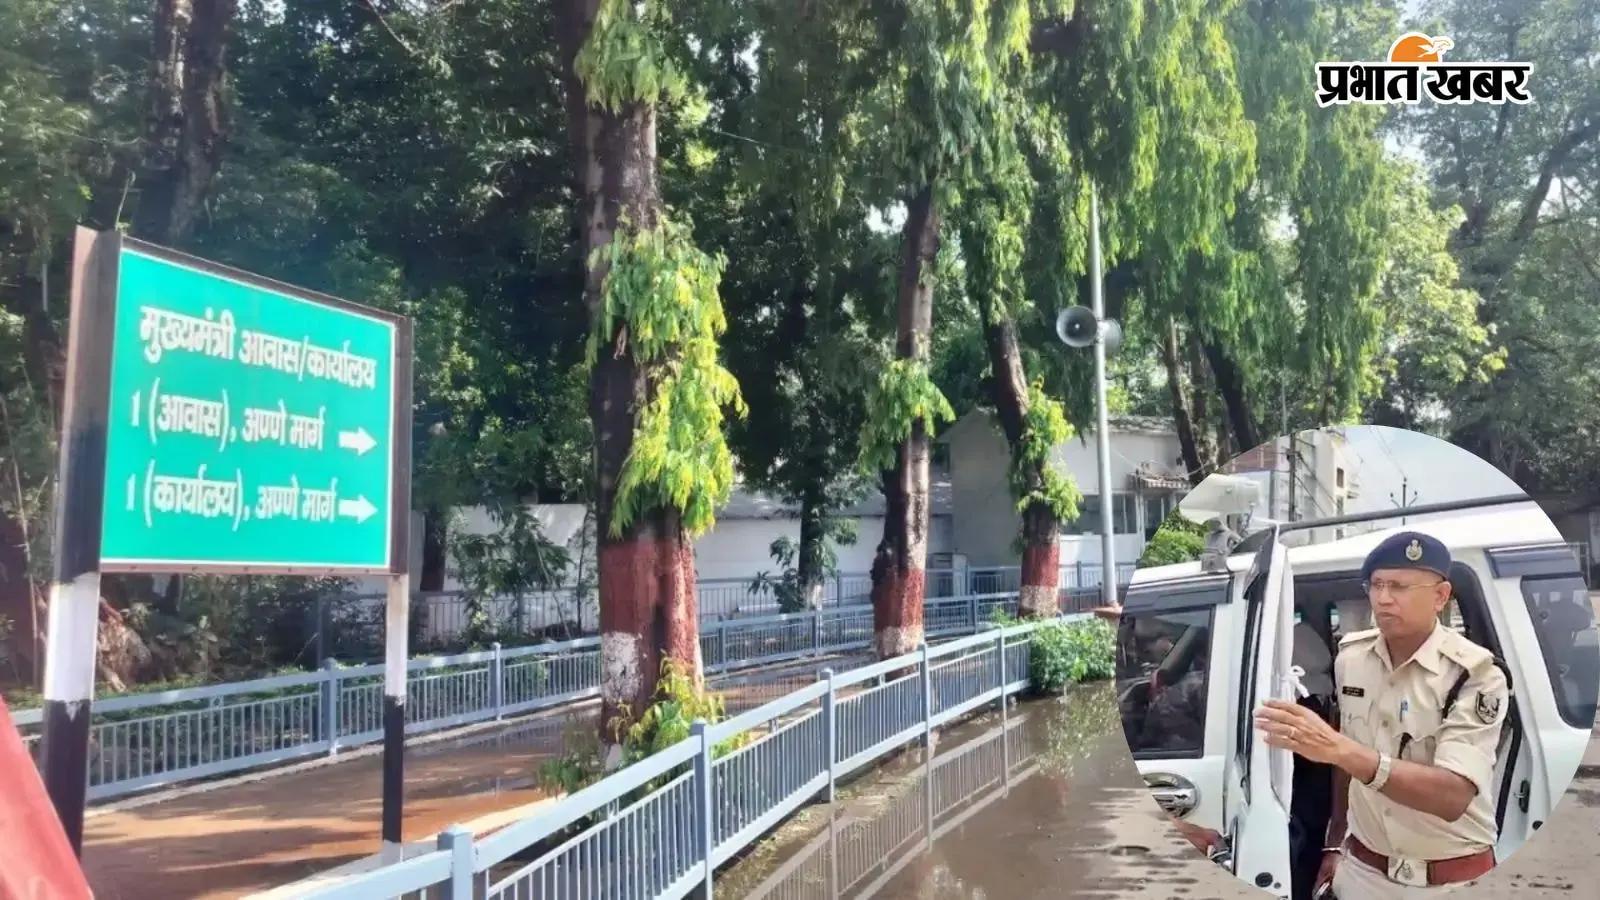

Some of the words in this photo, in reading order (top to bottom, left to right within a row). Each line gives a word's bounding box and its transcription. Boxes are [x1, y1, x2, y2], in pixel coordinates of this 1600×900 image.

[139, 306, 236, 364] मुख्यमंत्री
[238, 329, 378, 390] आवास/कार्यालय
[131, 389, 141, 427] 1
[149, 376, 237, 452] (आवास),
[242, 399, 287, 446] अण्णे
[289, 405, 326, 451] मार्ग
[126, 473, 136, 511] 1
[144, 459, 250, 532] (कार्यालय),
[256, 474, 300, 521] अण्णे
[302, 477, 338, 523] मार्ग
